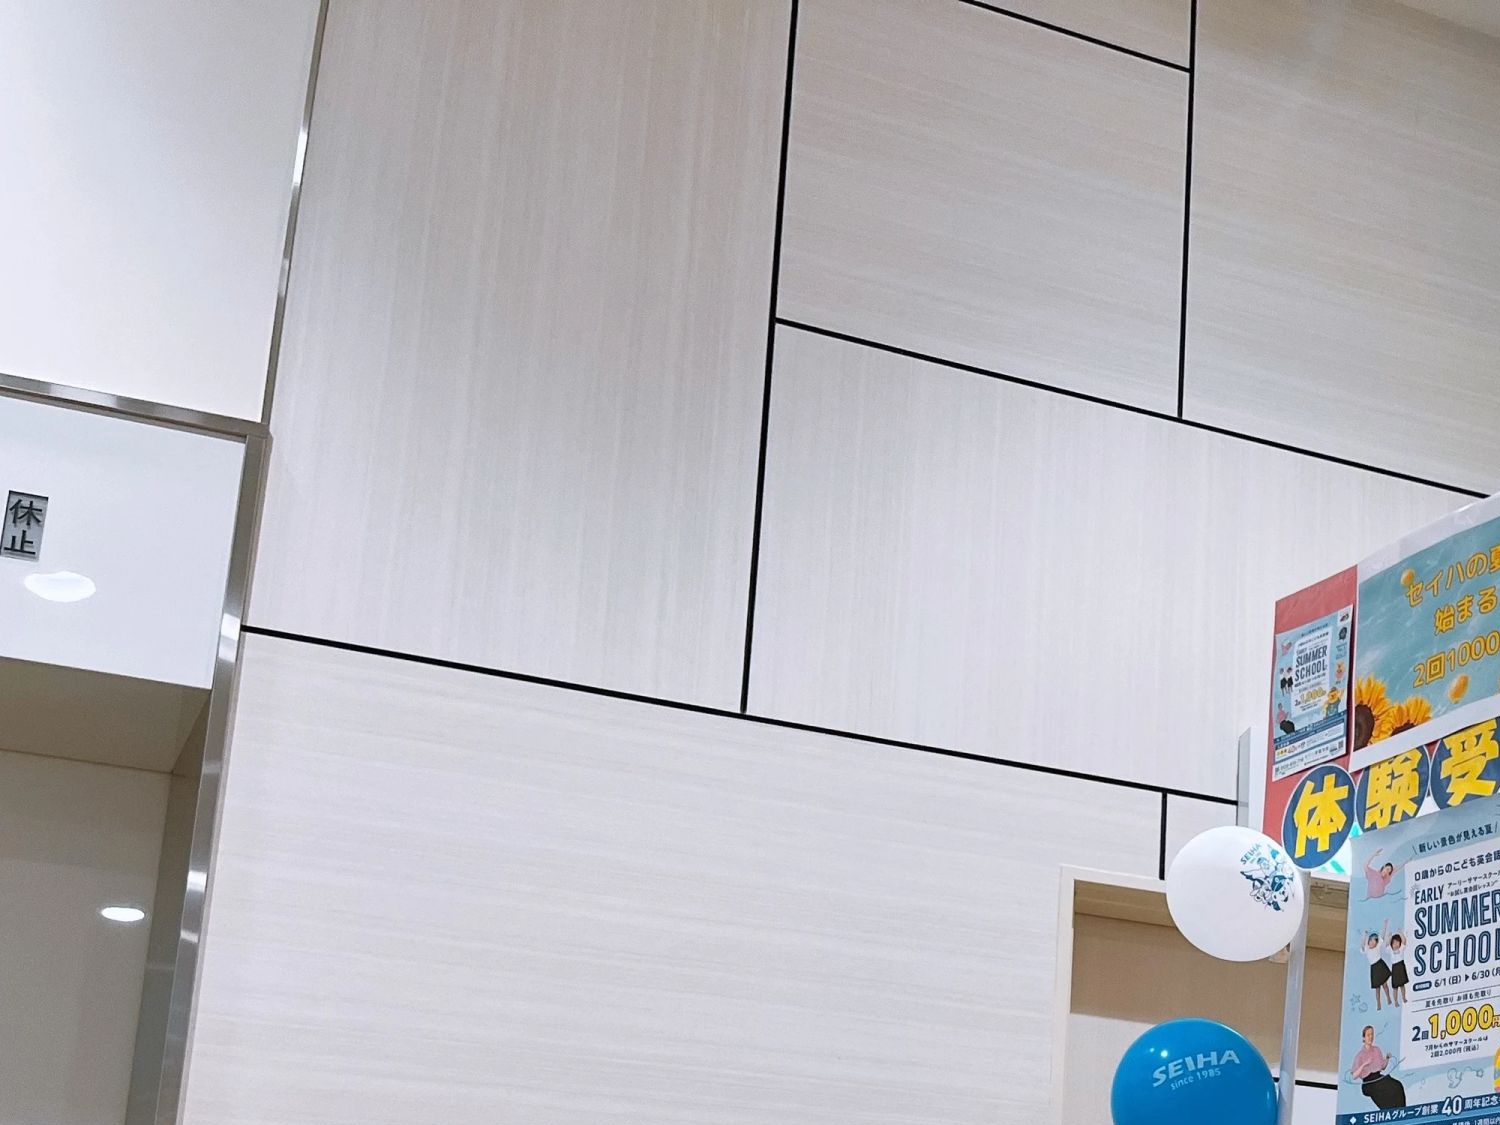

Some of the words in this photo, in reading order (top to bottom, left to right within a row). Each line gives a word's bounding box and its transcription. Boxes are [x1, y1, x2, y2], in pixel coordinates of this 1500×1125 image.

[4, 499, 42, 555] 休止
[1434, 586, 1499, 636] 始まる
[1296, 645, 1327, 668] SUMMER
[1295, 659, 1327, 682] SCHOOL
[1414, 885, 1444, 905] EARLY
[1153, 1050, 1240, 1087] SEIHA
[1170, 1075, 1194, 1090] since
[1197, 1068, 1221, 1080] 1985
